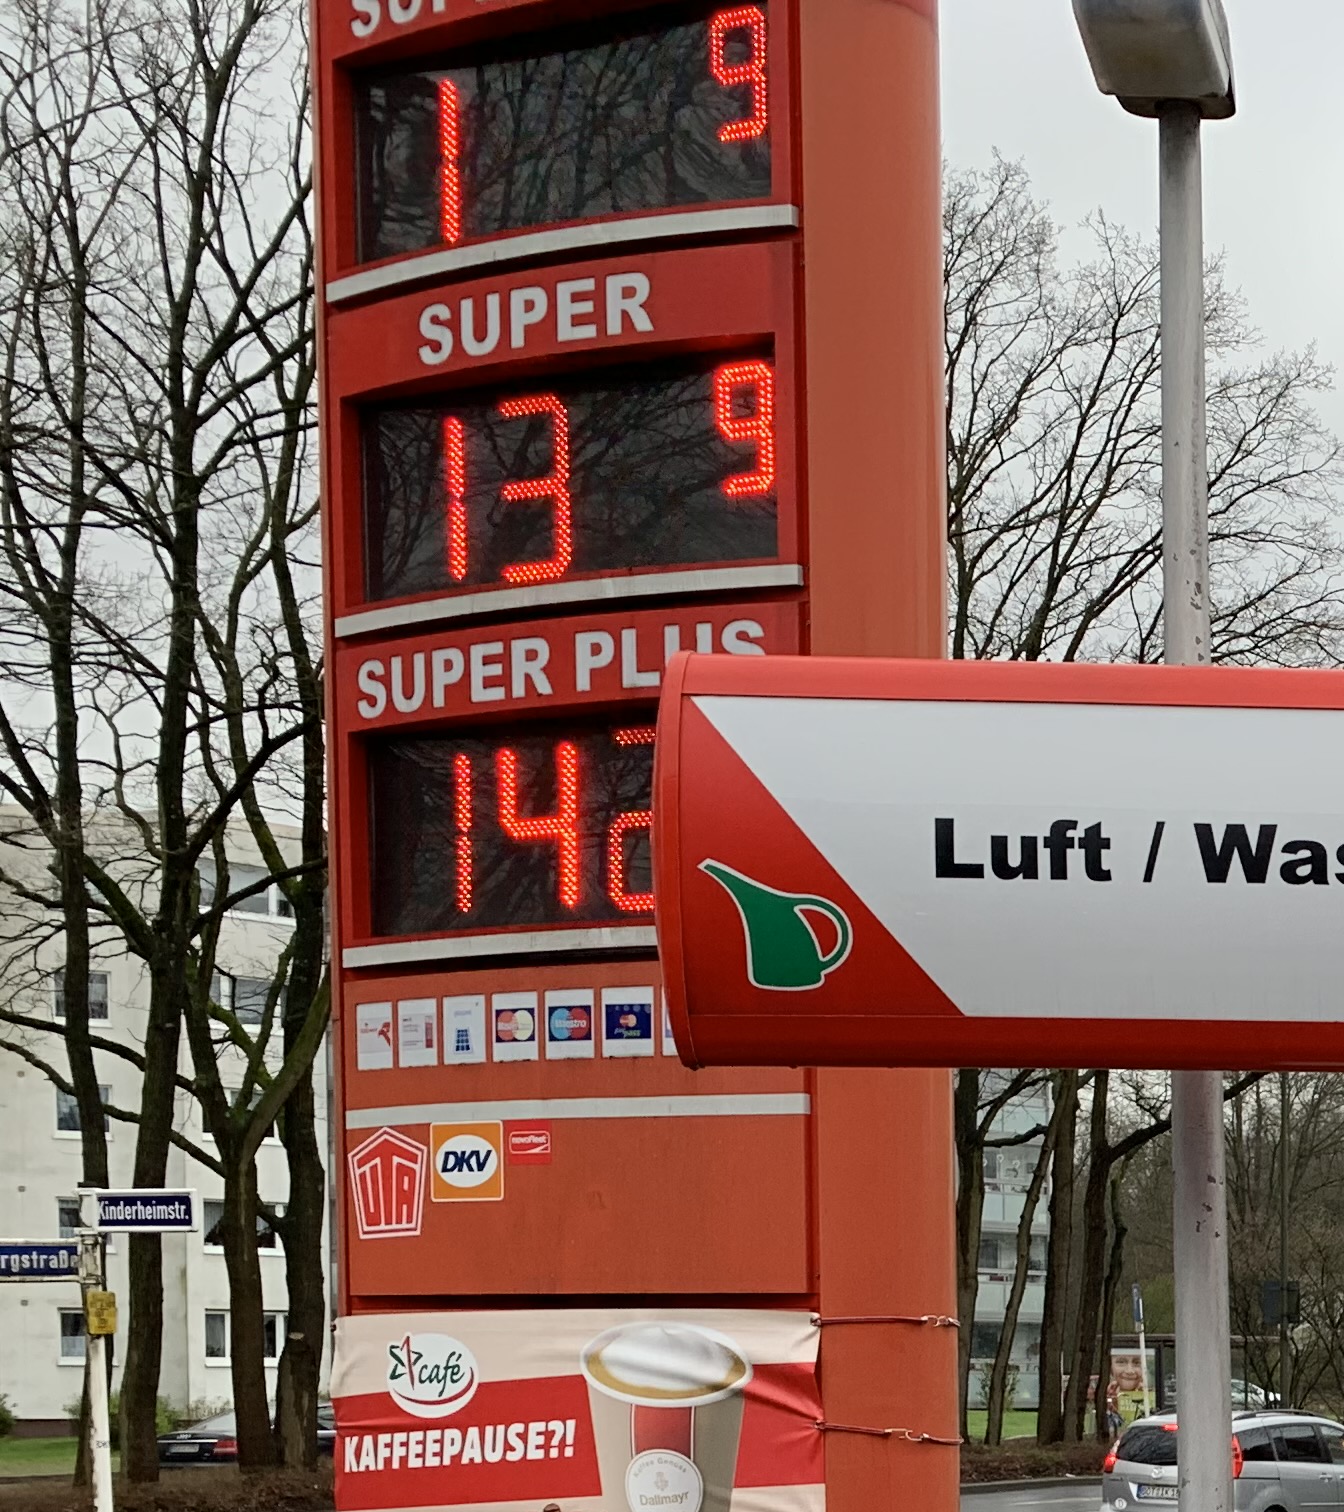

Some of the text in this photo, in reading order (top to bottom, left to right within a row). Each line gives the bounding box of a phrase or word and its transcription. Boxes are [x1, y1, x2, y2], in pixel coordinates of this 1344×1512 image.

[709, 5, 768, 143] 9
[417, 271, 655, 366] SUPER
[716, 360, 775, 497] 9
[356, 636, 553, 720] SUPER
[933, 817, 1112, 883] Luft
[1142, 820, 1165, 883] /
[441, 1149, 493, 1174] DKV
[418, 1350, 466, 1398] café
[344, 1418, 577, 1473] KAFFEEPAUSE?!
[639, 1490, 689, 1506] Dallmayr
